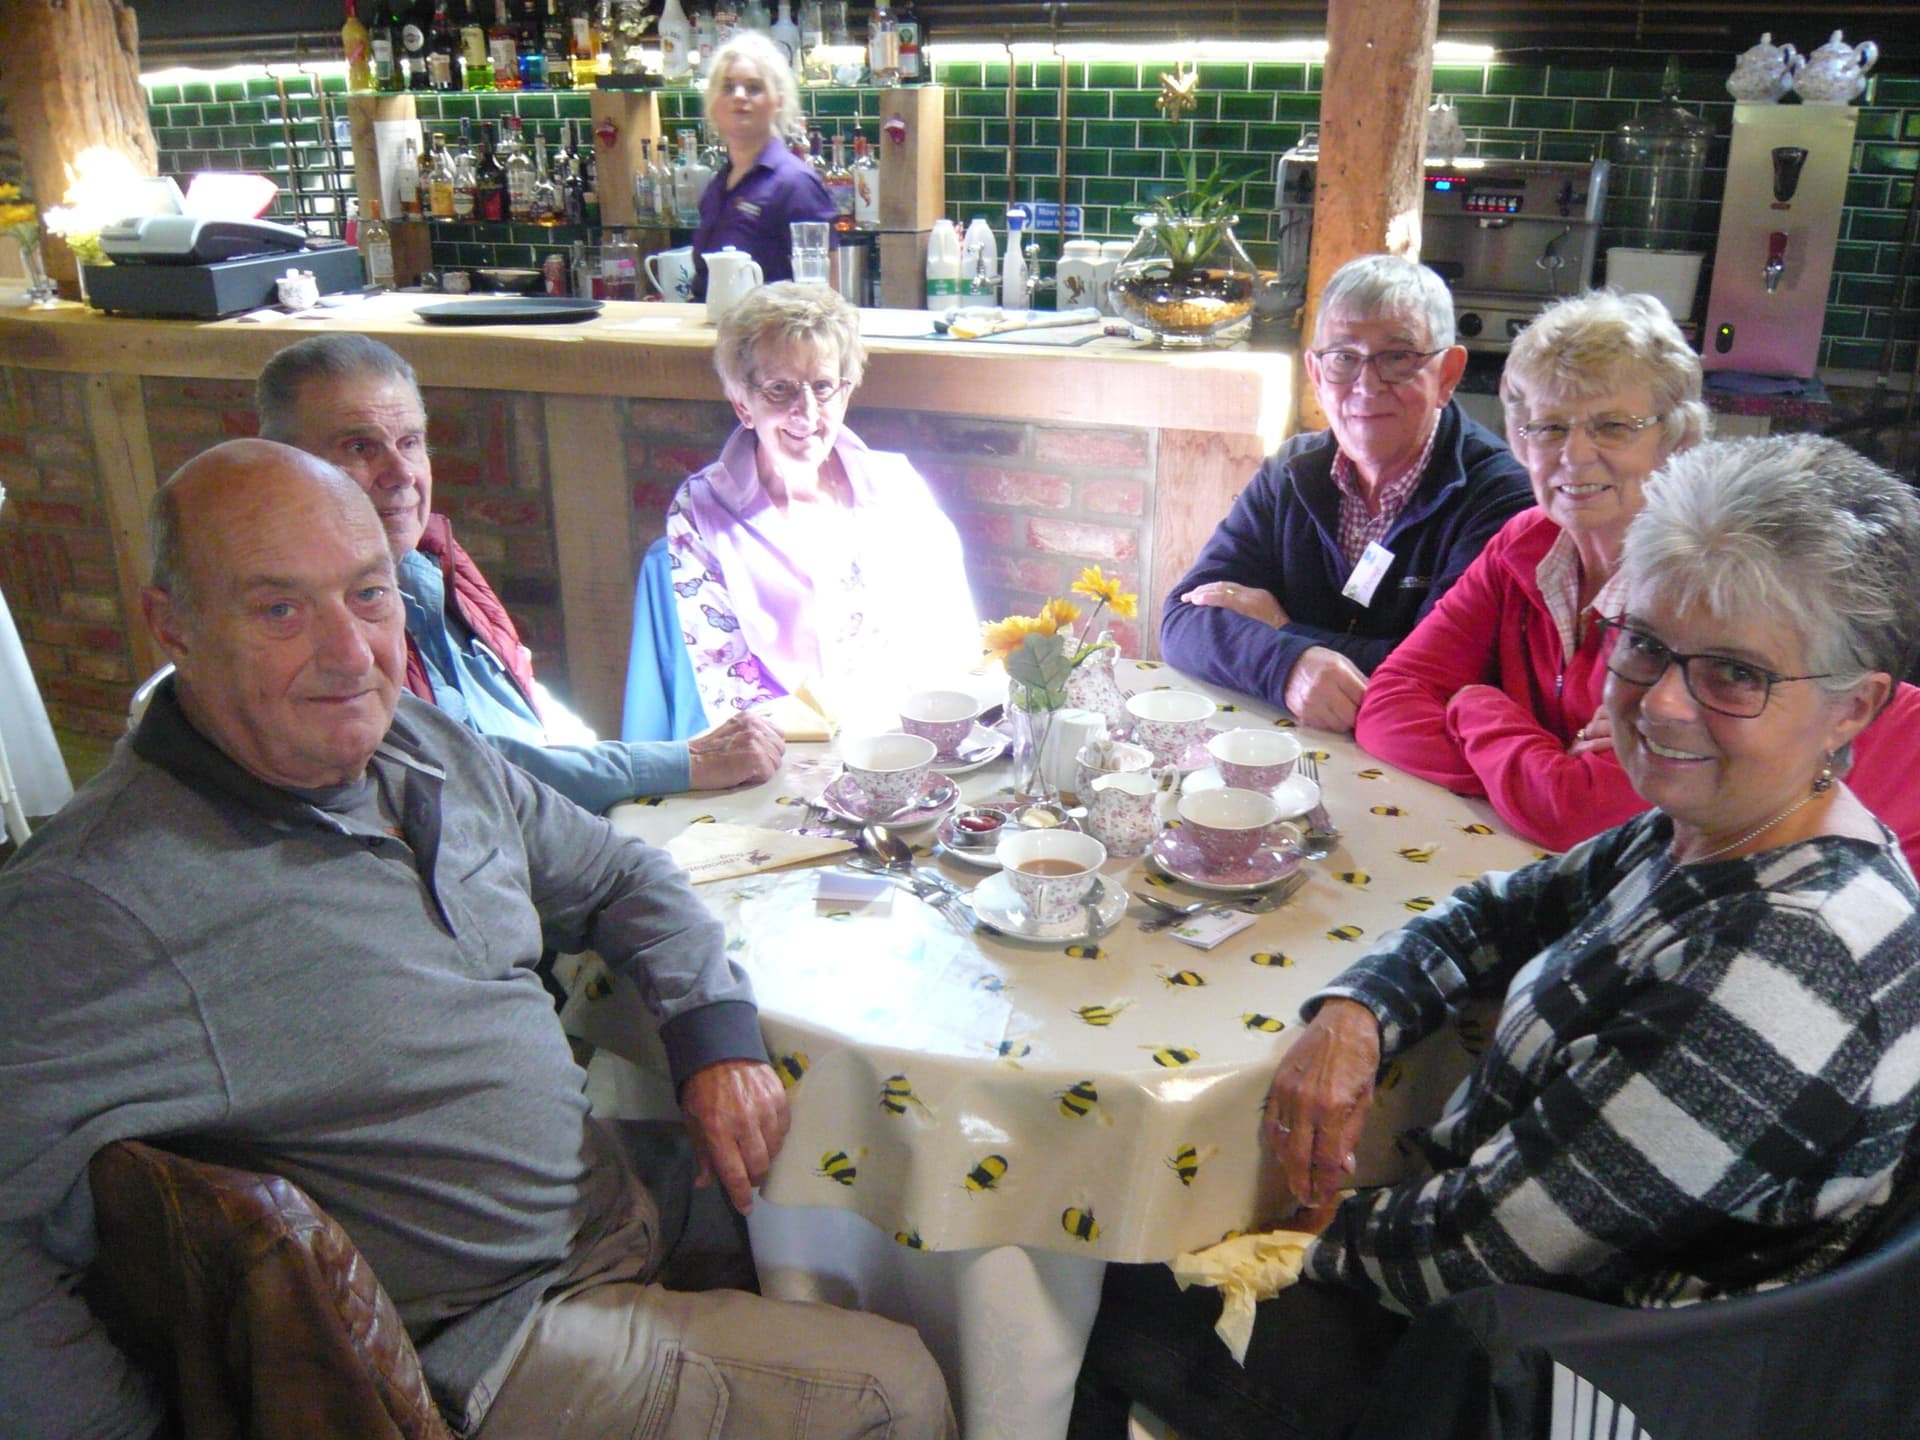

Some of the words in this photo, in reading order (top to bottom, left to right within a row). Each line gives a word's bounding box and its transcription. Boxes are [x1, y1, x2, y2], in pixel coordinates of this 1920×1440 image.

[1038, 207, 1056, 216] Now
[1036, 219, 1054, 228] your
[1054, 219, 1078, 228] hnds
